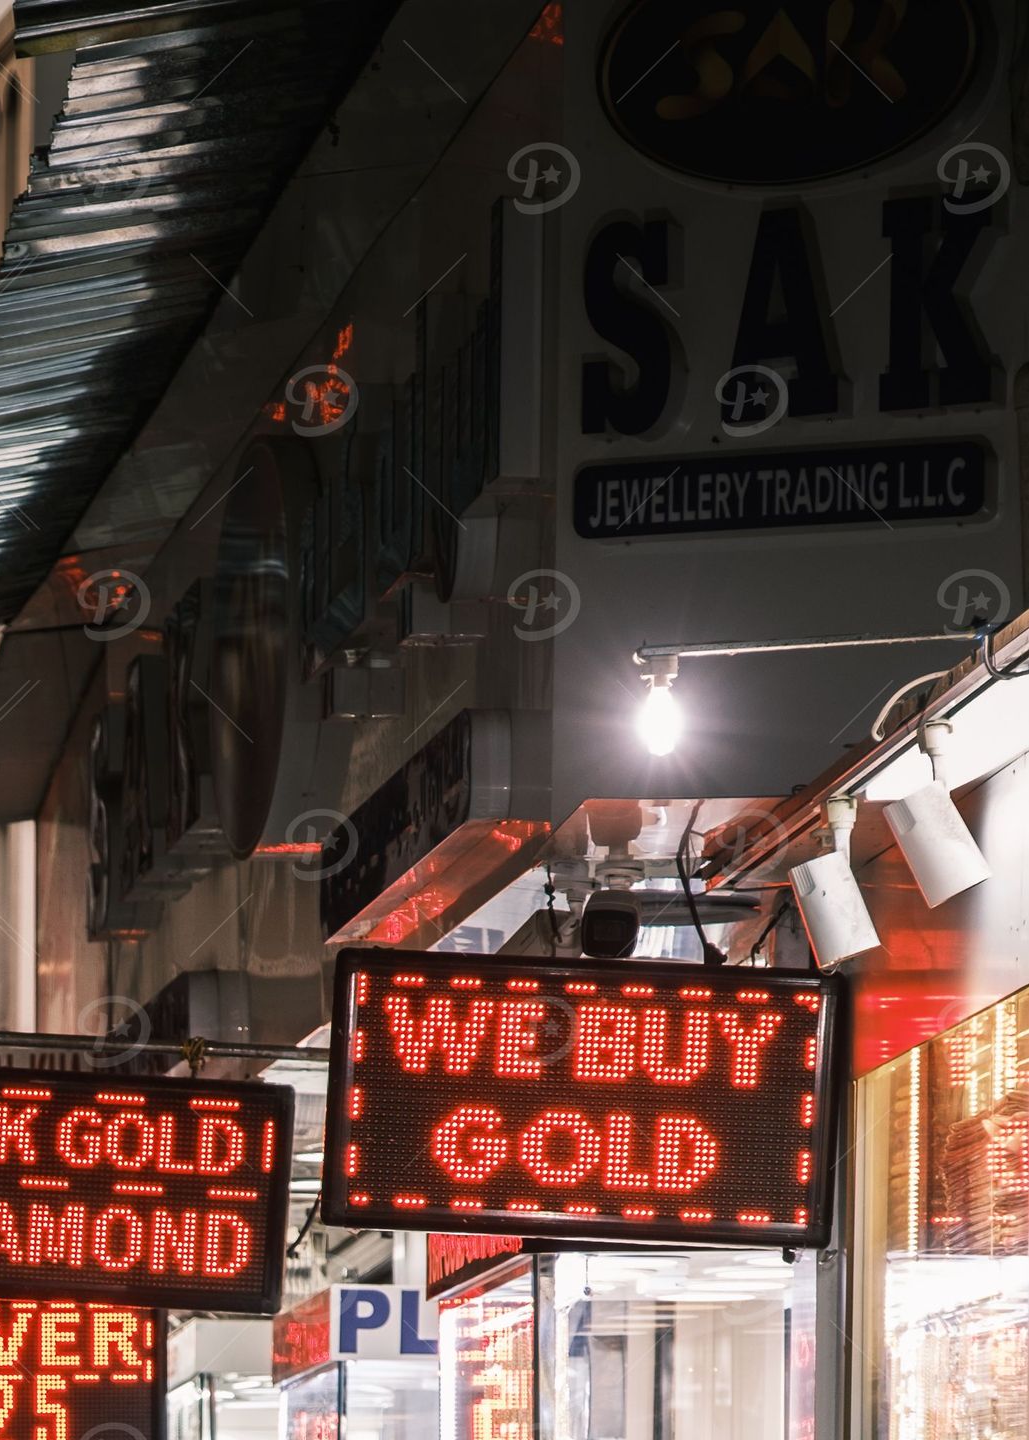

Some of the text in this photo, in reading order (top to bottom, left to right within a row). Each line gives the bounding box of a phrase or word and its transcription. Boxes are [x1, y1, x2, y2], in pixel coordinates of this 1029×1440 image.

[580, 194, 1002, 436] SAK
[589, 473, 751, 528] JEWELLERY
[757, 462, 889, 519] TRADING
[383, 995, 784, 1088] WE BUY
[57, 1108, 246, 1176] GOLD
[432, 1105, 719, 1192] GOLD
